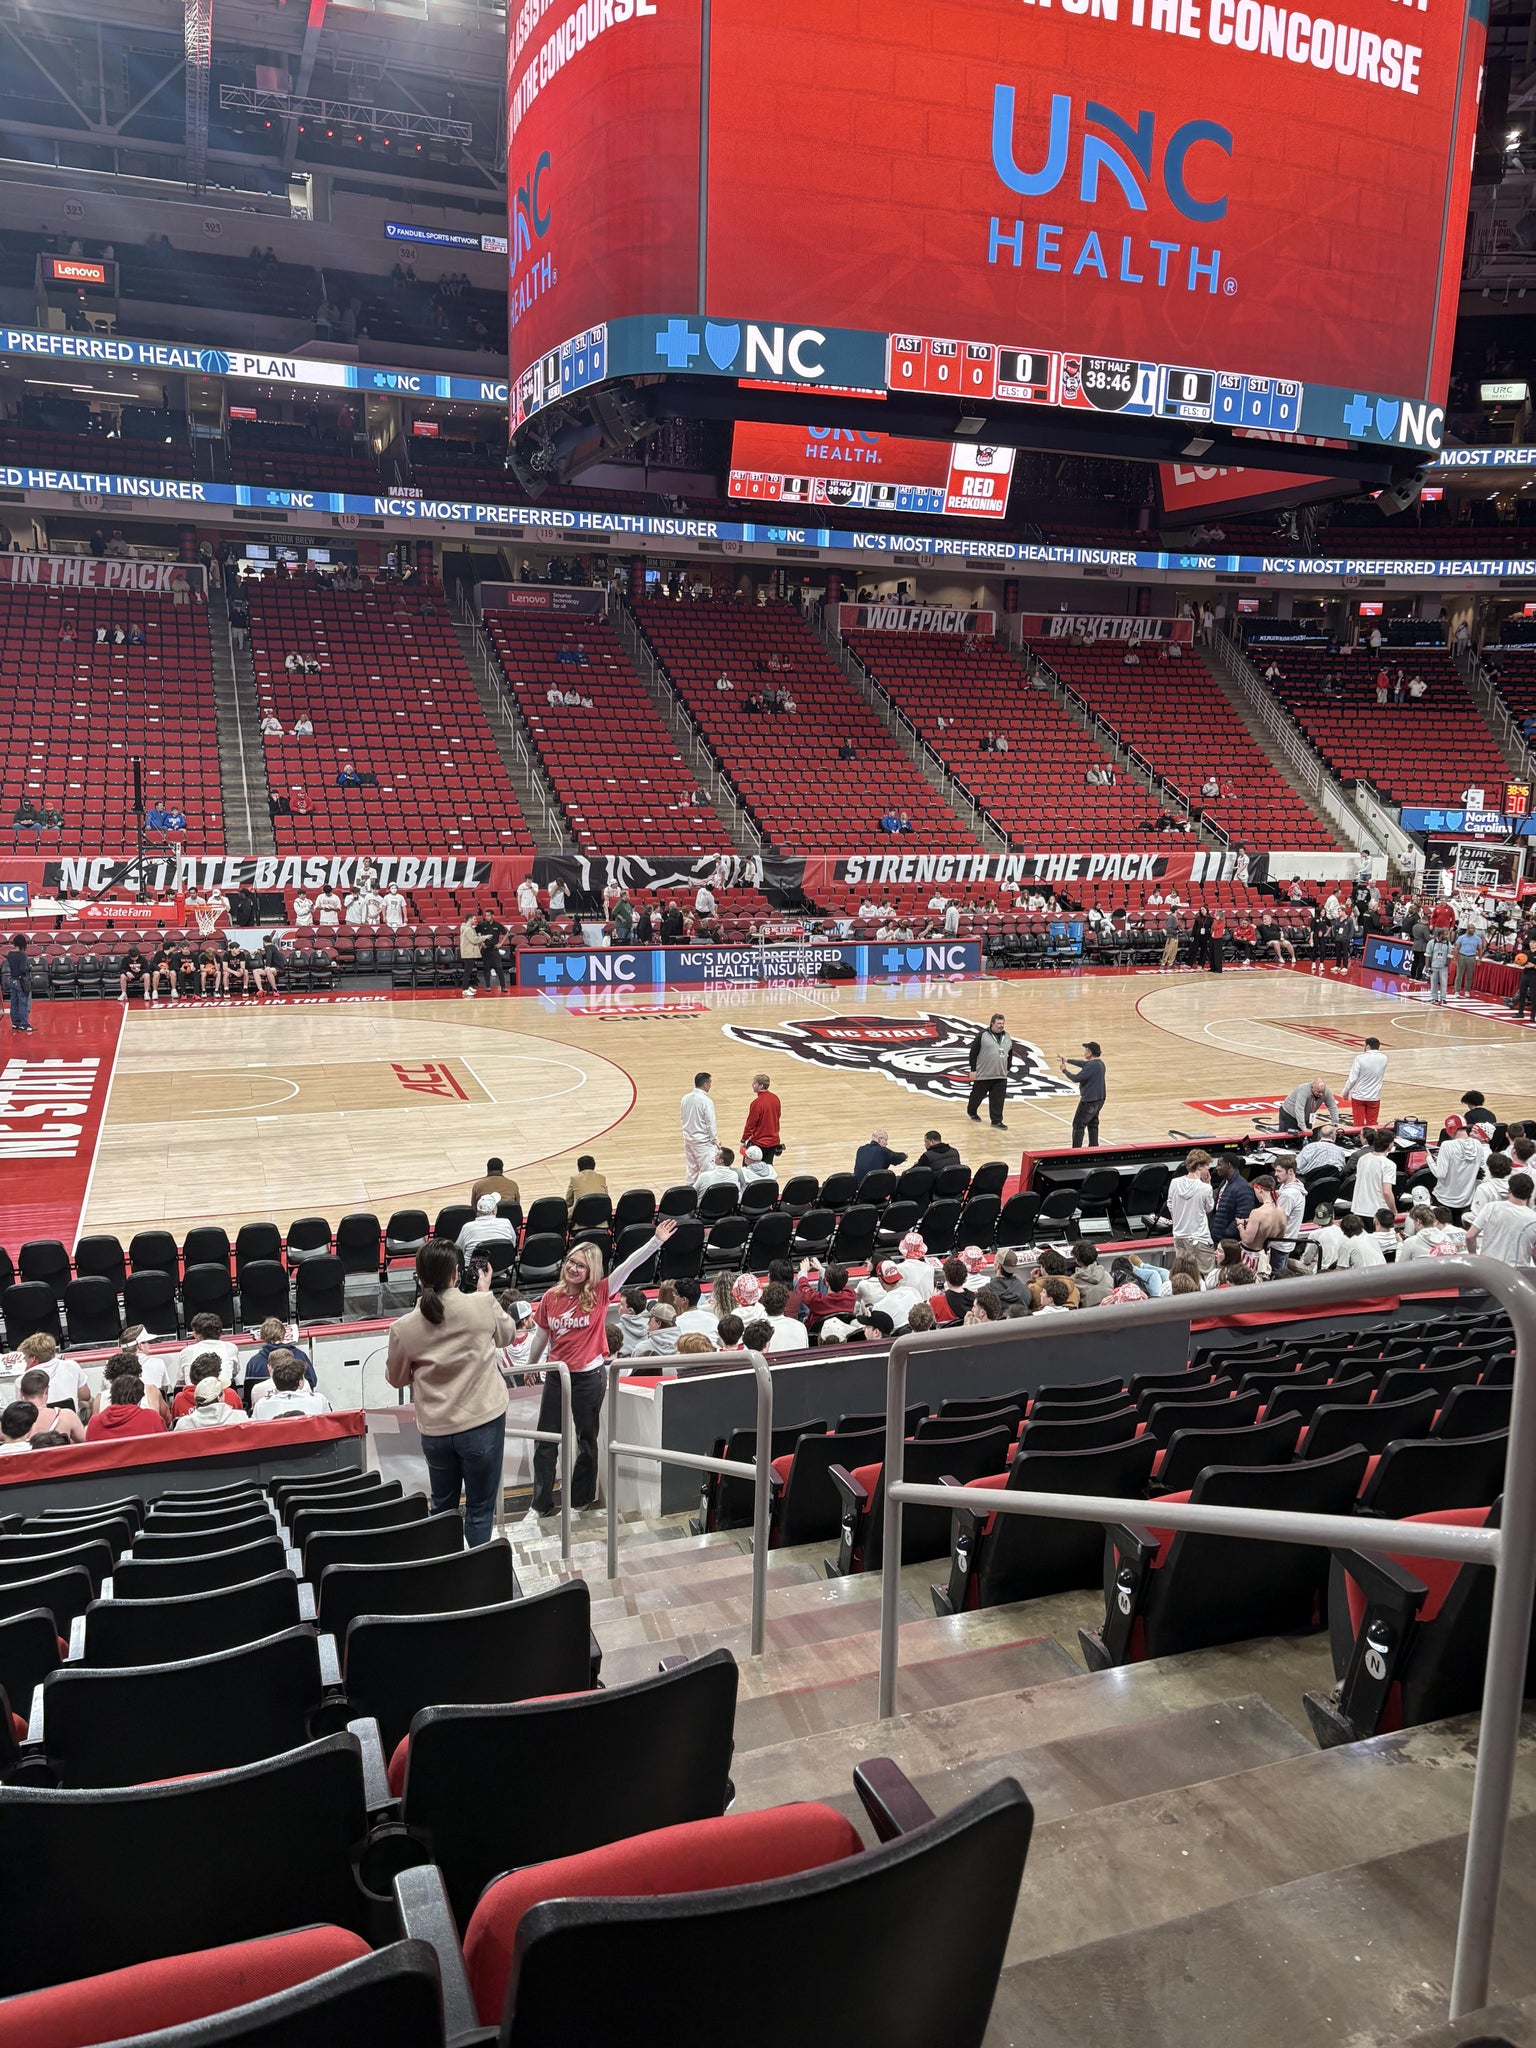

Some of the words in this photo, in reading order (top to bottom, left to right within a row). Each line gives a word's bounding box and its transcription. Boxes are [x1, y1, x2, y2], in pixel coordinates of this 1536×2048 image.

[540, 0, 657, 89] CONCOURSE
[1209, 0, 1423, 95] CONCOURSE
[990, 83, 1234, 223] UNC
[66, 204, 83, 216] 323
[204, 221, 222, 233] 323
[397, 228, 426, 238] FANDUEL
[426, 232, 449, 241] SPORTS
[450, 236, 479, 246] NETWORK
[58, 263, 100, 280] Lenovo
[575, 337, 586, 351] STL
[592, 330, 601, 342] TO
[7, 331, 134, 361] PREFERRED
[746, 324, 827, 379] NC
[898, 338, 920, 352] AST
[933, 341, 955, 356] STL
[971, 345, 988, 359] TO
[244, 358, 296, 379] PLAN
[902, 360, 913, 378] 0
[938, 364, 949, 381] 0
[1016, 353, 1033, 383] 0
[1089, 359, 1106, 371] 1ST
[1107, 361, 1131, 373] HALF
[396, 375, 421, 391] NC
[973, 368, 983, 385] 0
[1085, 371, 1132, 393] 38:46
[1220, 376, 1240, 389] AST
[1182, 373, 1198, 401] 0
[1249, 379, 1268, 392] STL
[1279, 382, 1294, 395] TO
[1223, 396, 1233, 413] 0
[1252, 400, 1261, 416] 0
[1280, 403, 1289, 419] 0
[1399, 401, 1444, 449] NC
[805, 443, 877, 464] HEALTH
[1440, 450, 1492, 465] MOST
[28, 470, 111, 494] HEALTH
[116, 477, 206, 501] INSURER
[827, 485, 852, 496] 38:46
[961, 476, 995, 498] RED
[290, 492, 314, 508] NC
[947, 496, 1004, 512] RECKONING
[374, 498, 416, 517] NC'S
[420, 502, 472, 520] MOST
[476, 506, 575, 527] PREFERRED
[579, 514, 644, 533] HEALTH
[648, 518, 718, 538] INSURER
[270, 534, 294, 545] STORM
[295, 536, 315, 545] BREW
[786, 529, 805, 543] NC
[725, 542, 737, 551] 120
[853, 533, 887, 549] NC'S
[890, 536, 933, 553] MOST
[935, 538, 1016, 558] PREFERRED
[1018, 545, 1074, 563] HEALTH
[1077, 549, 1137, 566] INSURER
[1198, 557, 1216, 568] NC
[1262, 558, 1295, 572] NC'S
[1298, 560, 1343, 574] MOST
[1346, 561, 1436, 576] PREFERRED
[1439, 561, 1503, 576] HEALTH
[1507, 562, 1536, 576] INS
[11, 556, 40, 583] IN
[48, 558, 99, 588] THE
[103, 561, 175, 590] PACK
[511, 593, 547, 604] Lenovo
[865, 606, 970, 633] WOLFPACK
[1050, 616, 1164, 640] BASKETBALL
[1507, 785, 1530, 797] 38:46
[1508, 796, 1527, 814] 30
[1465, 811, 1499, 823] North
[59, 856, 115, 892] NC
[845, 855, 991, 885] STRENGTH
[997, 854, 1027, 882] IN
[1034, 853, 1085, 882] THE
[1086, 853, 1158, 882] PACK
[0, 887, 25, 903] NC
[681, 952, 714, 966] NC'S
[722, 951, 759, 964] MOST
[763, 949, 842, 963] PREFERRED
[925, 946, 966, 971] NC
[589, 954, 637, 982] NC
[703, 965, 759, 978] HEALTH
[151, 999, 257, 1009] STRENGTH
[335, 995, 388, 1003] PACK
[579, 1003, 696, 1015] Lenovo
[598, 1012, 701, 1023] Center
[826, 1029, 862, 1038] NC
[864, 1028, 932, 1038] STATE
[0, 1058, 101, 1118] STATE
[390, 1063, 455, 1098] ACC
[0, 1123, 83, 1159] NC
[547, 1314, 590, 1331] WOLFPACK
[1369, 1657, 1381, 1673] N
